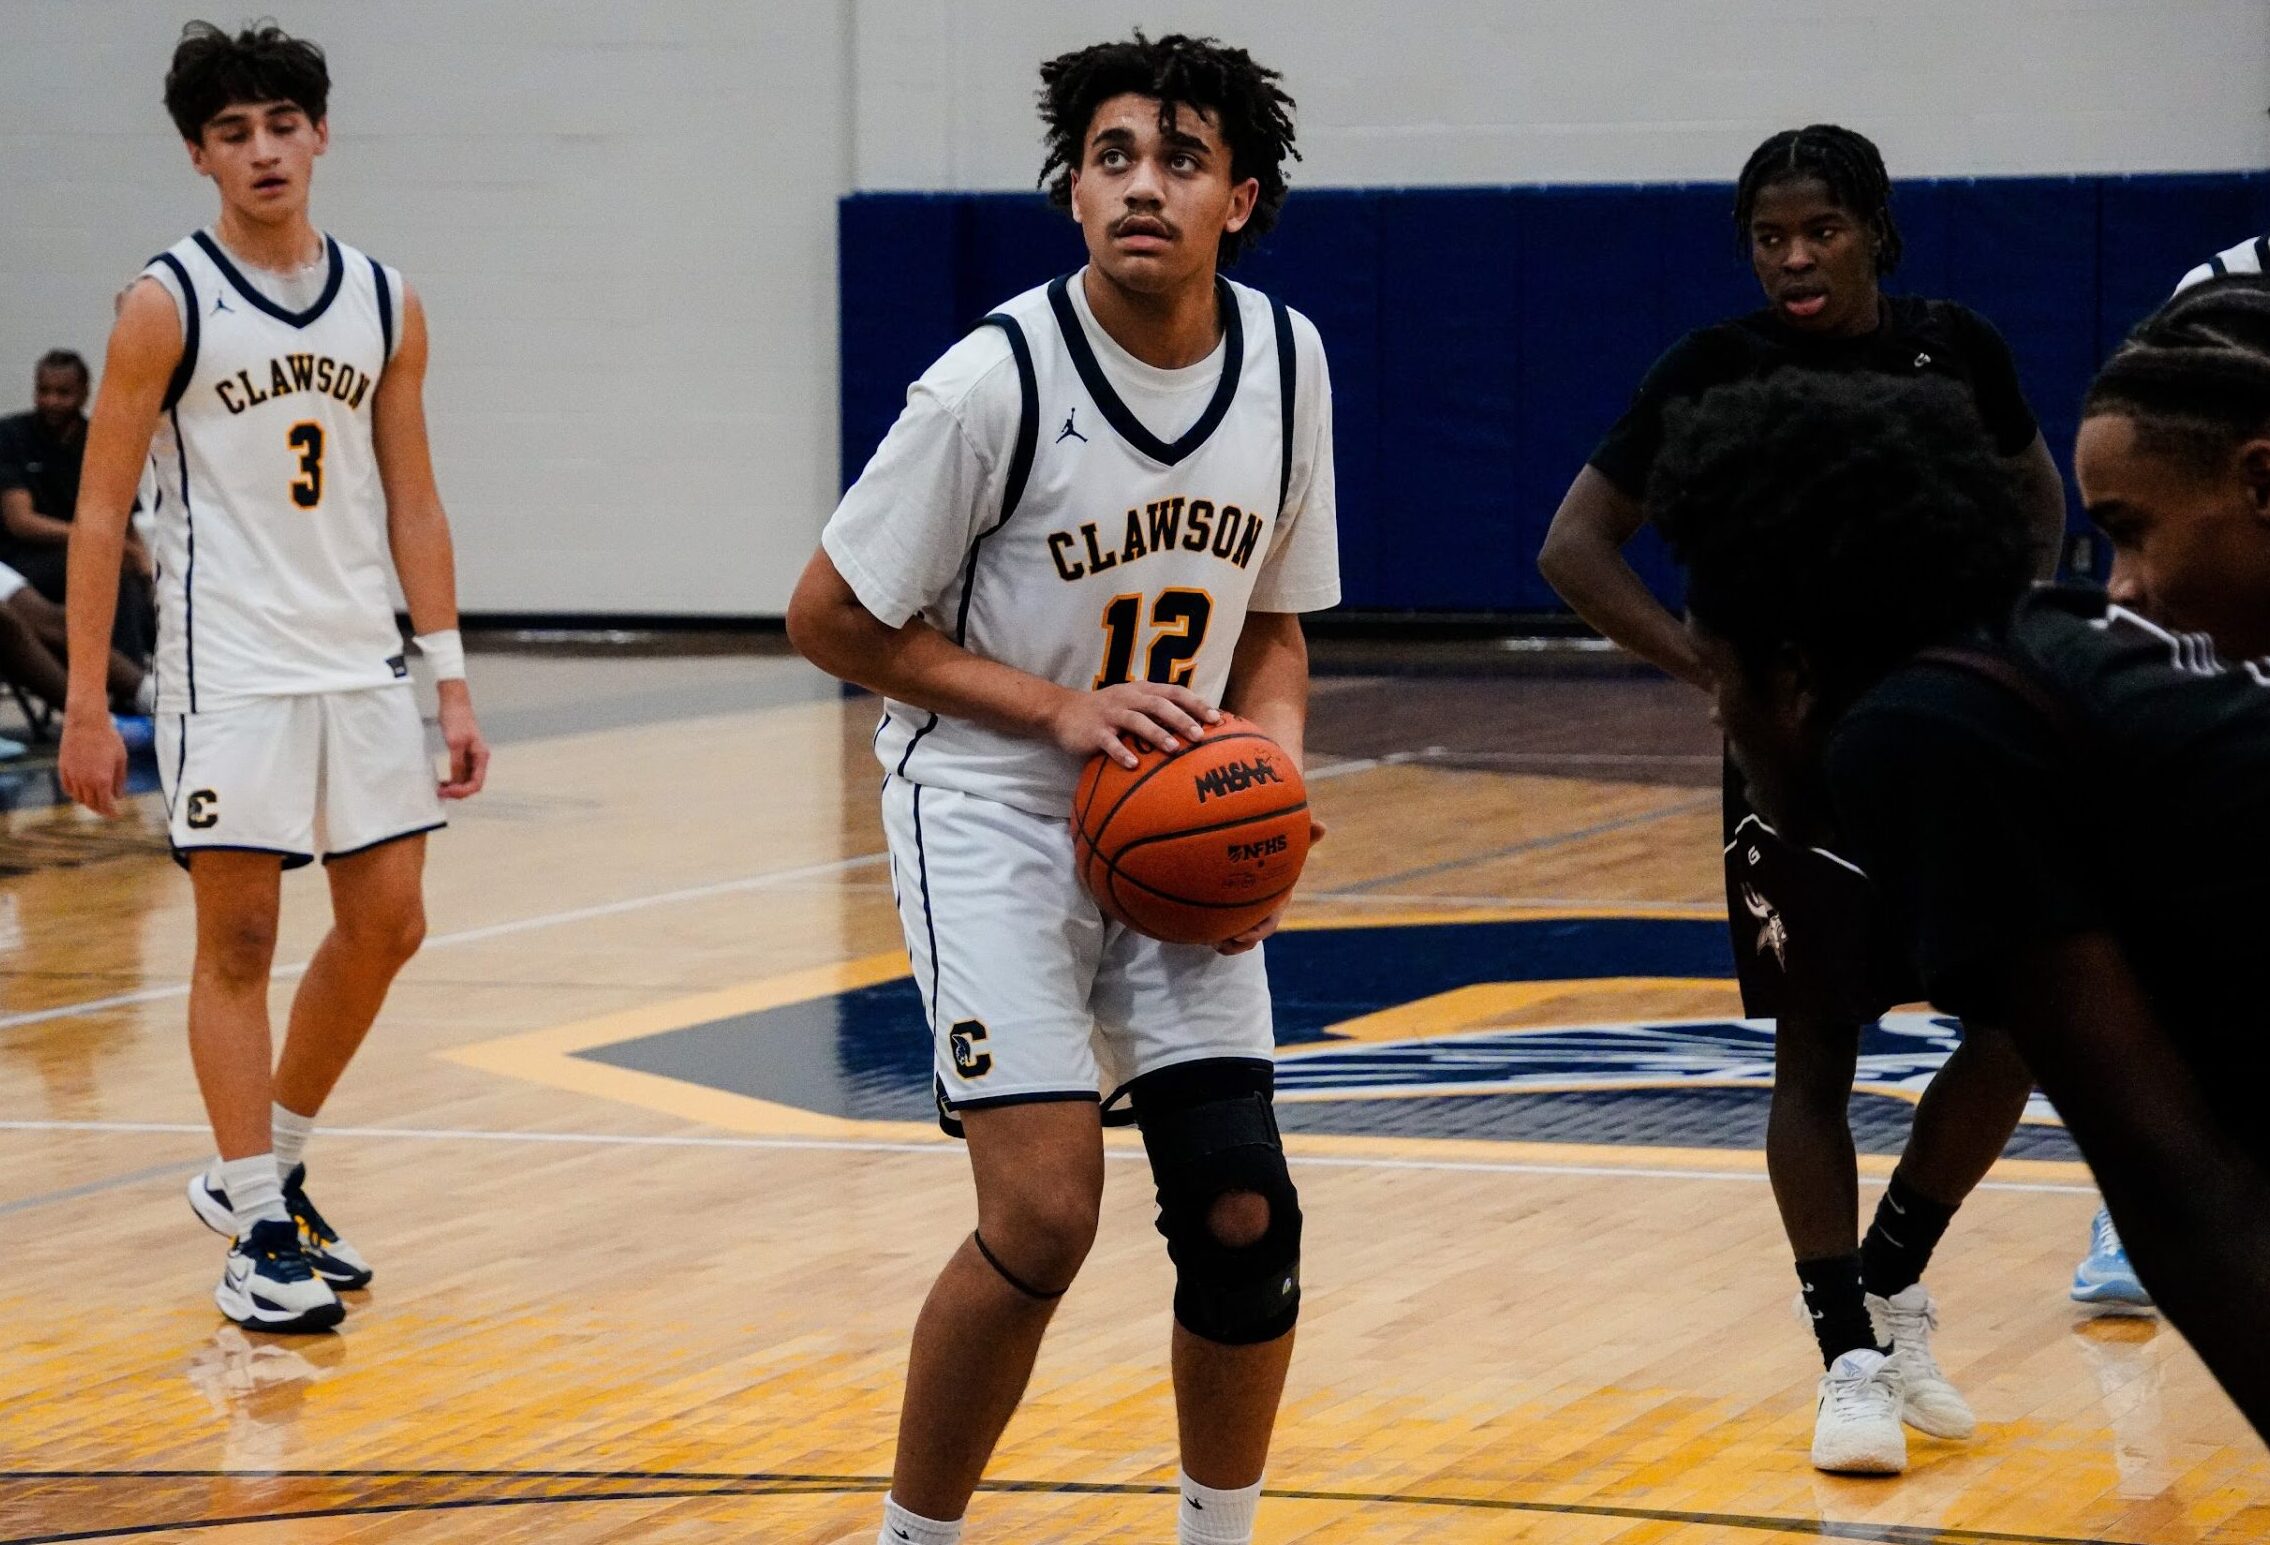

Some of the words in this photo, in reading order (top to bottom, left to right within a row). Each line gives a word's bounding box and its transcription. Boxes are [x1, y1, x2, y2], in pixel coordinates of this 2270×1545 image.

[215, 354, 370, 414] CLAWSON
[286, 420, 325, 511] 3
[1047, 497, 1264, 582] CLAWSON
[1091, 587, 1216, 691] 12
[187, 789, 218, 829] C
[1243, 834, 1288, 861] NFHS
[949, 1019, 992, 1079] C
